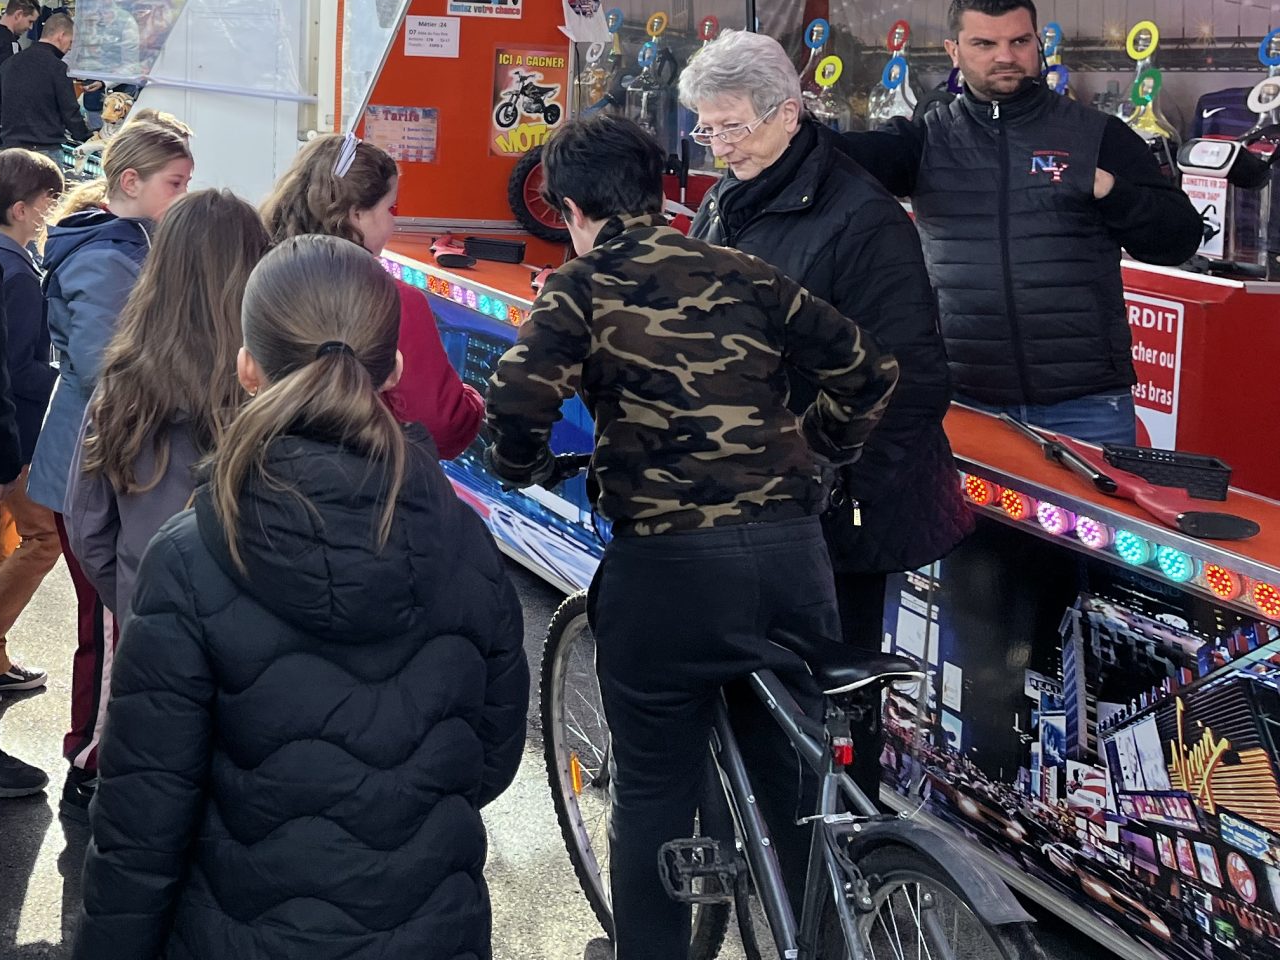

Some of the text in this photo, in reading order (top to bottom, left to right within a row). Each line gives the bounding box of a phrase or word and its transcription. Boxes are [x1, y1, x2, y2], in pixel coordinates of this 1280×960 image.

[474, 5, 493, 14] votre
[495, 6, 520, 15] chance
[499, 53, 565, 68] ICI A GAGNER
[1127, 305, 1177, 333] RDIT
[1131, 341, 1175, 369] cher ou
[1148, 380, 1173, 406] bras
[1170, 696, 1230, 815] Virgin
